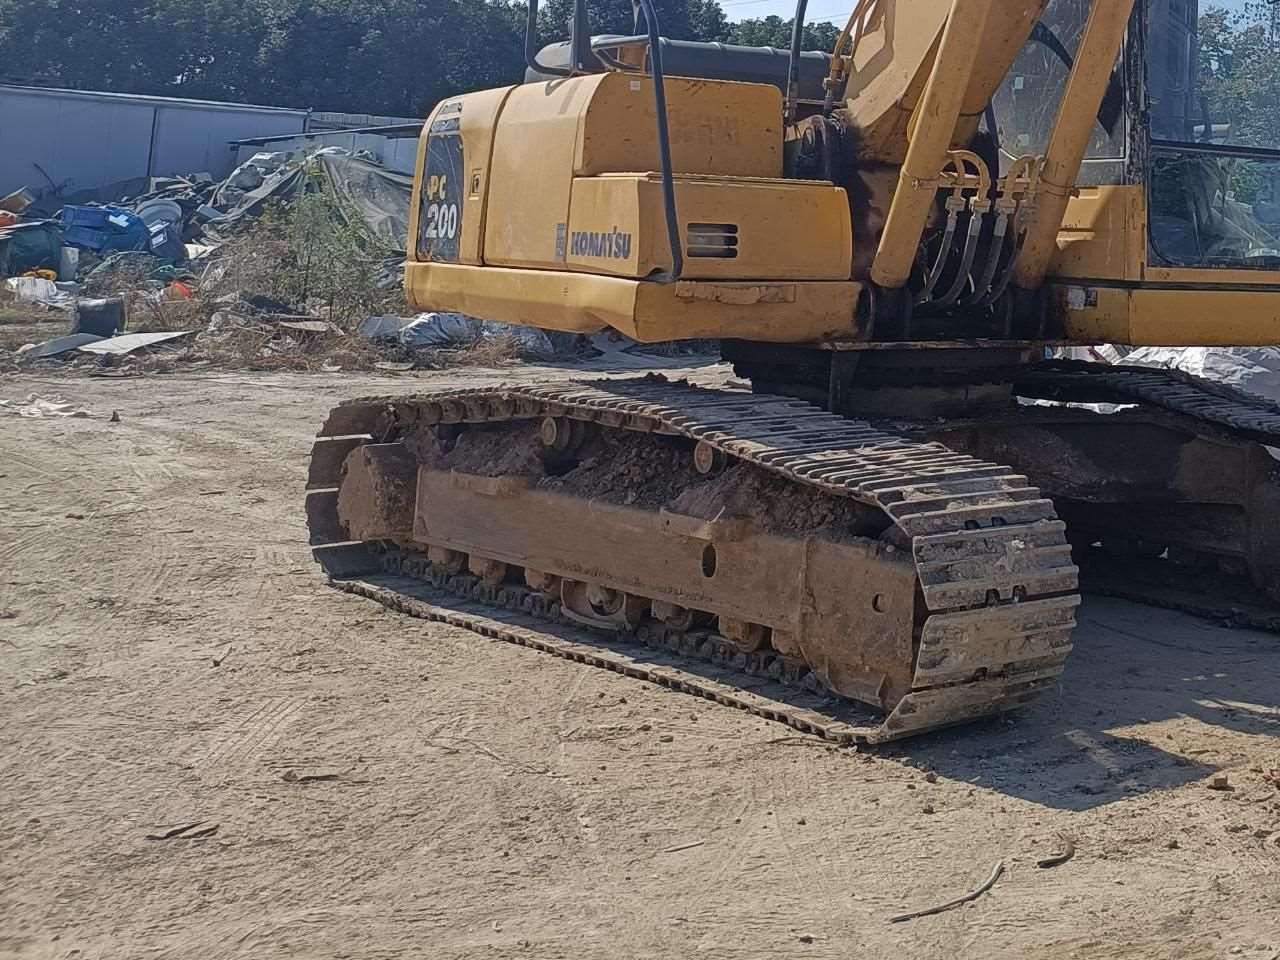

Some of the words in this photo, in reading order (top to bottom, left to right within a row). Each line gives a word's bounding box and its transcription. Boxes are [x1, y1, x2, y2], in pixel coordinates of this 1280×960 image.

[427, 175, 447, 200] PC
[426, 203, 457, 239] 200
[571, 225, 631, 259] KOMATSU
